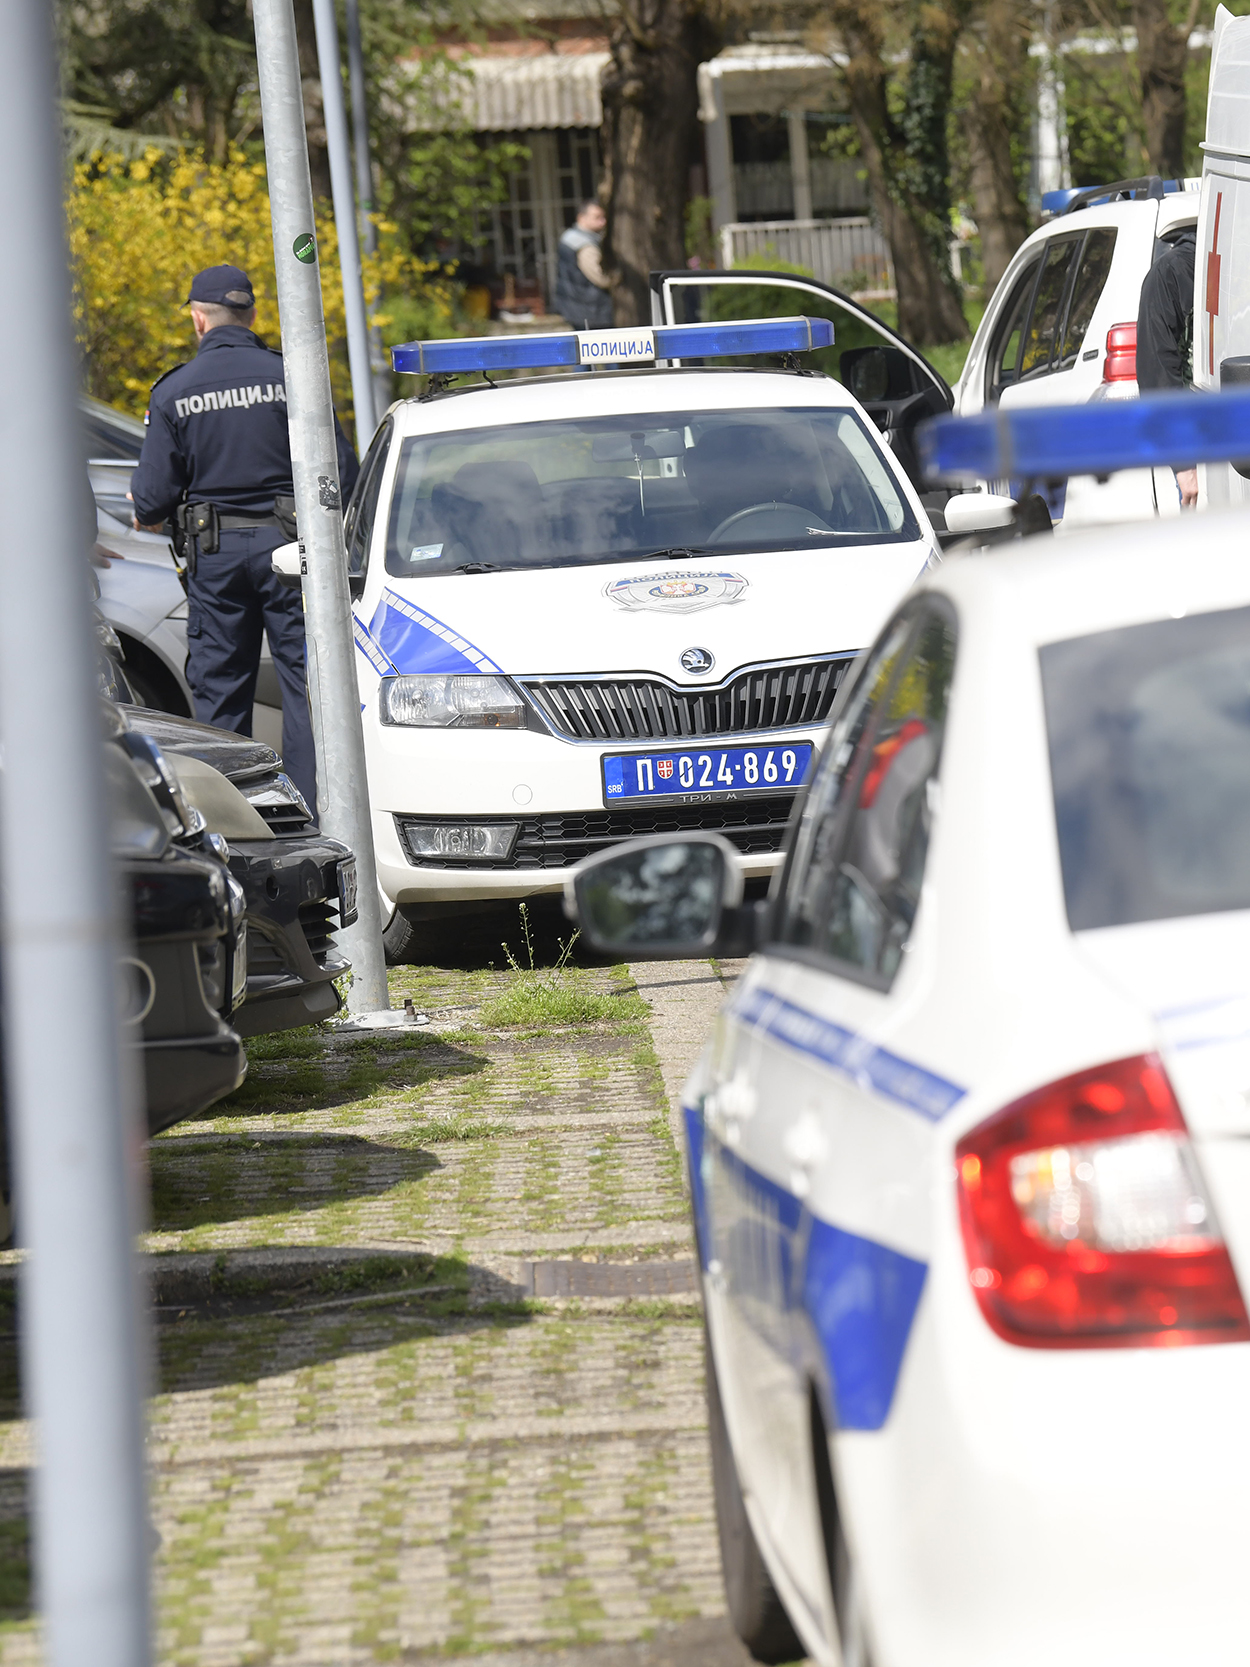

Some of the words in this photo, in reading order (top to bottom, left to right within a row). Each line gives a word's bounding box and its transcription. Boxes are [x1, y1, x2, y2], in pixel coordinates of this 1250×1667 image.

[581, 340, 653, 358] ПОЛИЦИЈА
[175, 383, 287, 418] ПОЛИЦИЈА
[607, 784, 623, 794] SRB
